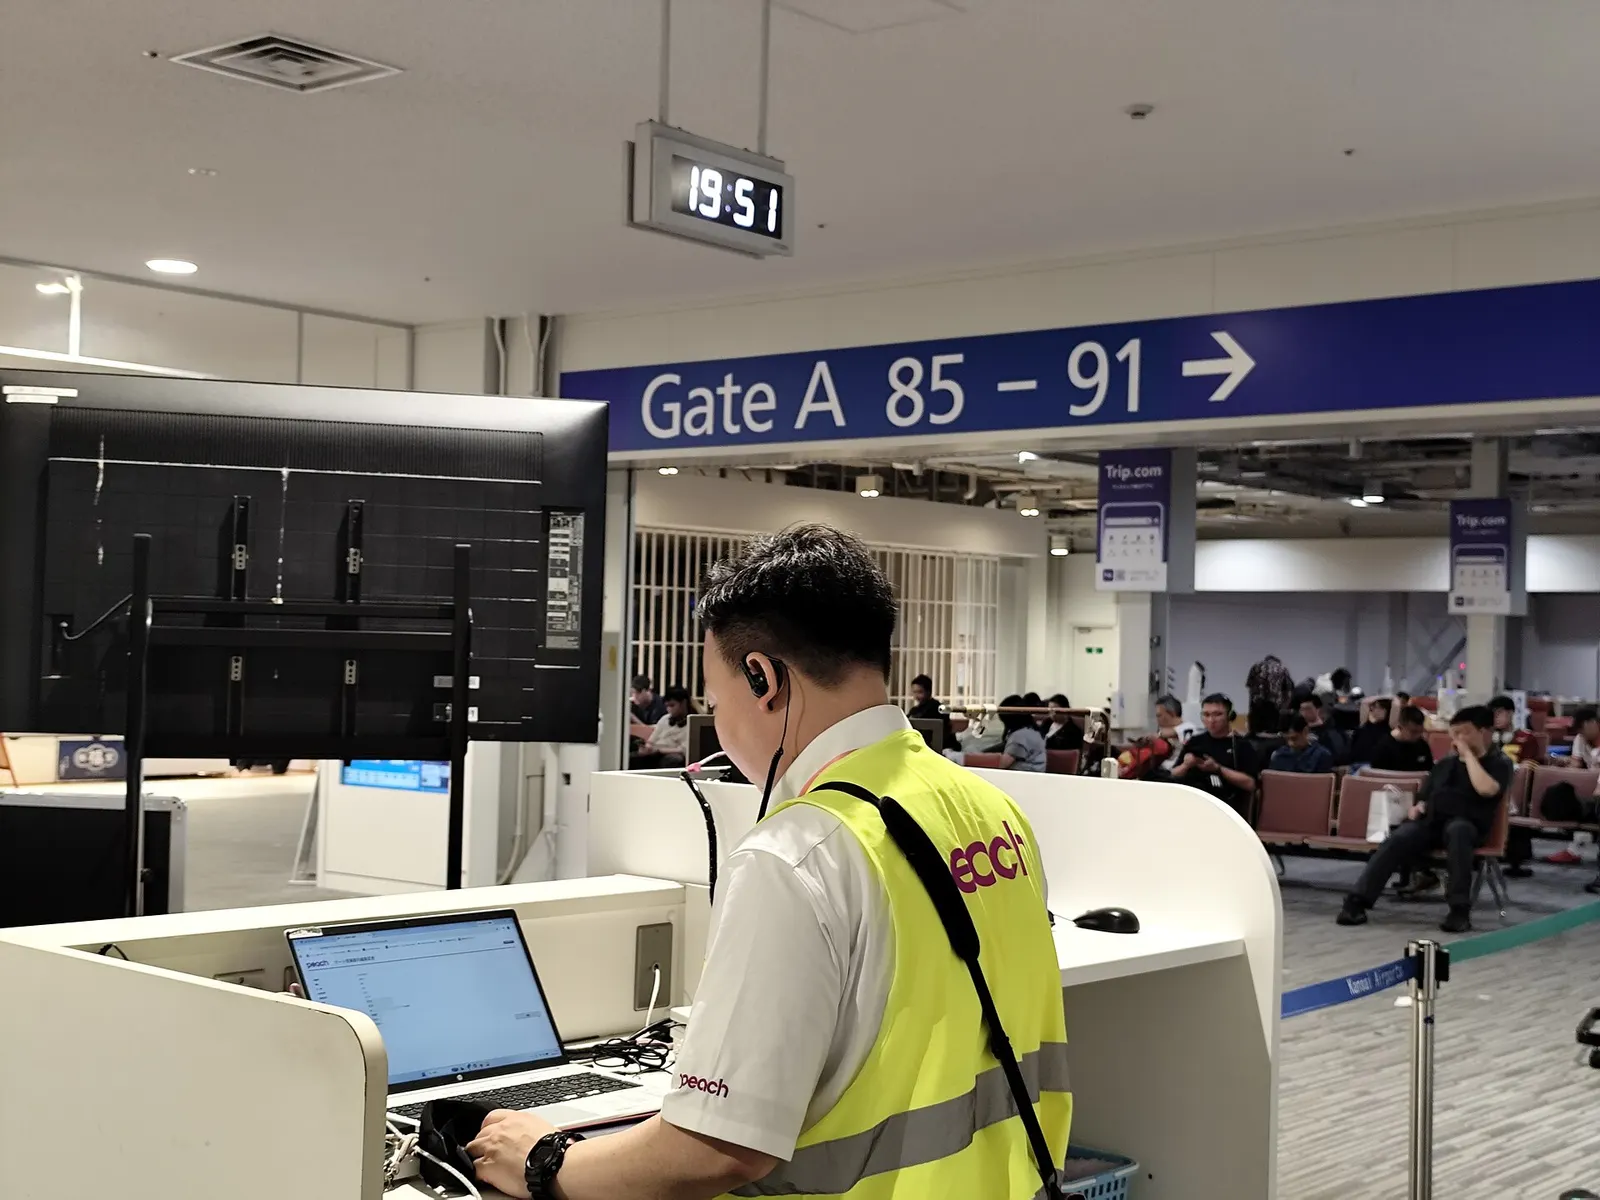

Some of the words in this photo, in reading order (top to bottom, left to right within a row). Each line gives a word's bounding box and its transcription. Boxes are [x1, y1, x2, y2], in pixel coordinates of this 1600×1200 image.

[688, 166, 778, 232] 19:51
[641, 373, 777, 440] Gate
[794, 361, 847, 429] A
[885, 353, 965, 427] 85
[1067, 338, 1141, 417] 91
[1105, 464, 1163, 482] Trip.com
[679, 1073, 729, 1099] peach
